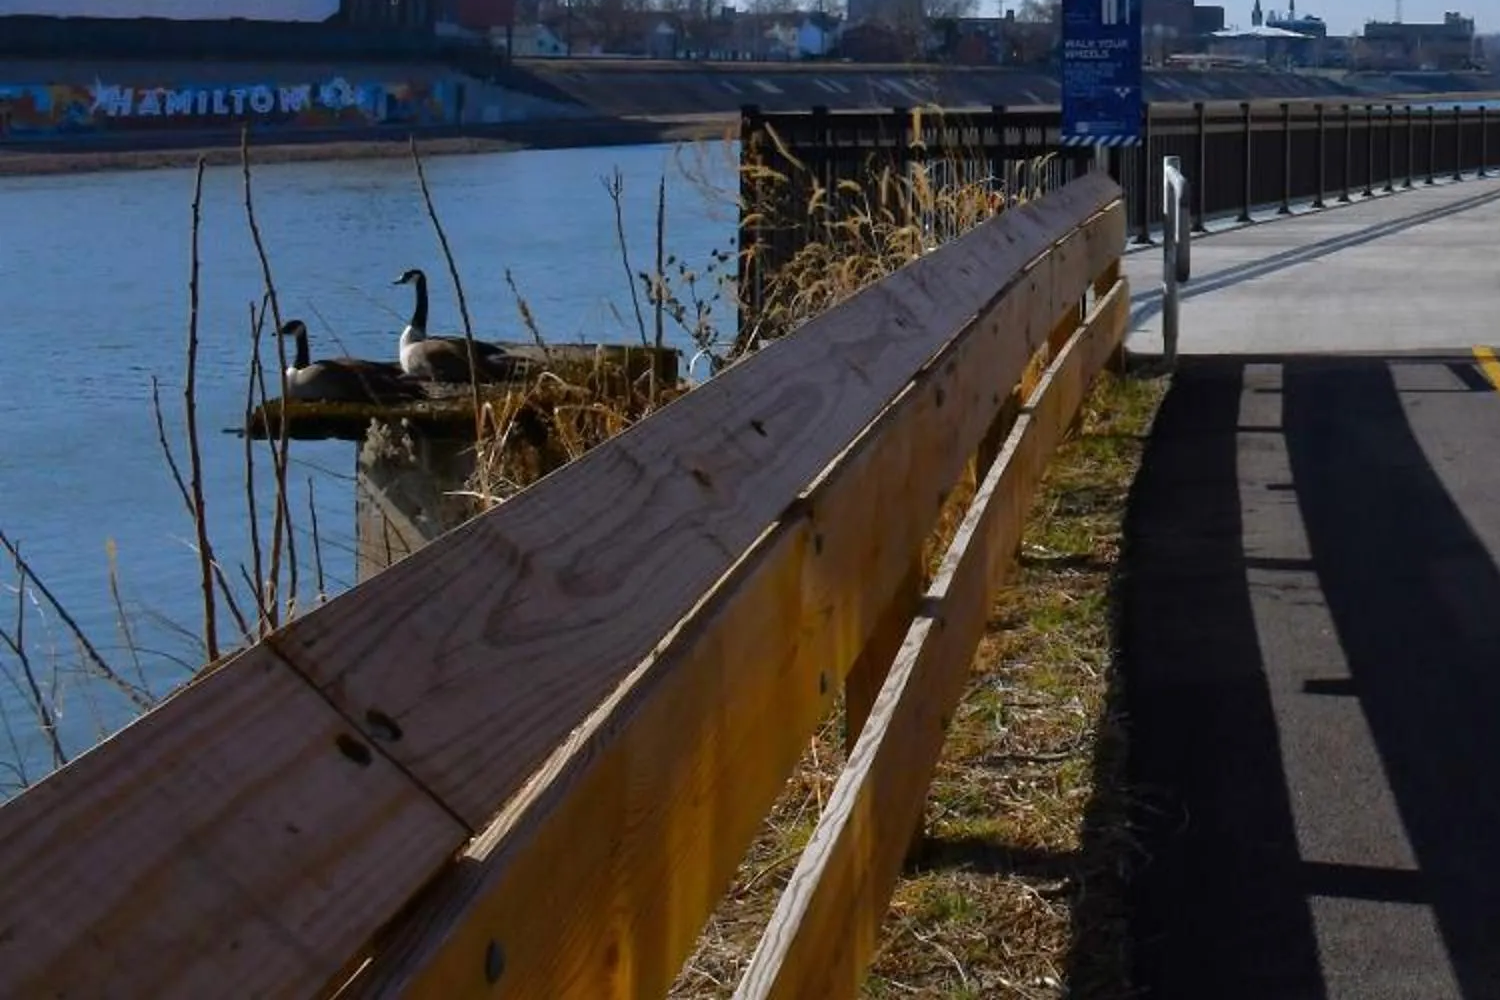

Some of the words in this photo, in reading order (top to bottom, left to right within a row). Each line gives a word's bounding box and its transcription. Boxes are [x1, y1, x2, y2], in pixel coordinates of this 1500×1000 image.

[1065, 39, 1095, 49] WALK
[1097, 39, 1128, 49] YOUR
[1065, 49, 1110, 59] WHEELS
[107, 84, 311, 117] HAMILTON
